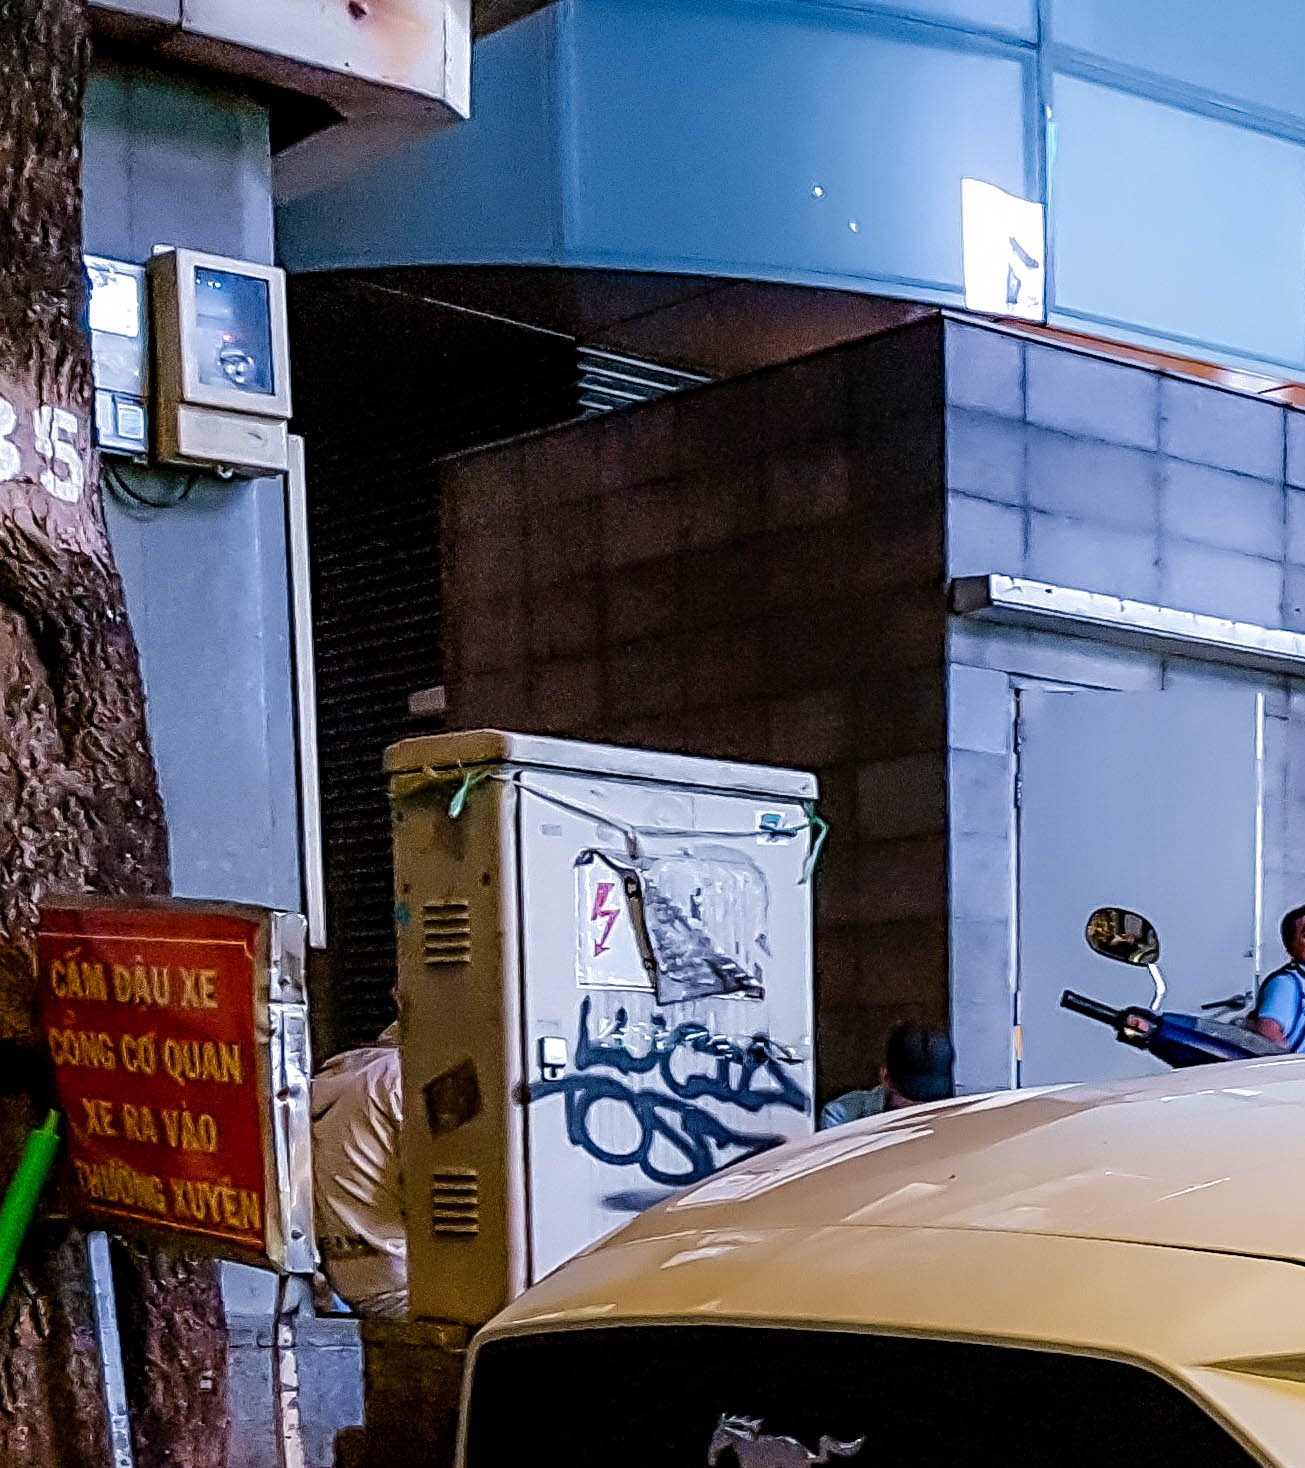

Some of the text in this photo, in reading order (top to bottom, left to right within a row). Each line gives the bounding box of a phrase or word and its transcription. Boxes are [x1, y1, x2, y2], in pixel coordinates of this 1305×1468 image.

[178, 967, 219, 1009] XE
[164, 1037, 243, 1086] QUAN
[81, 1098, 117, 1135] XE
[122, 1103, 159, 1144] RA
